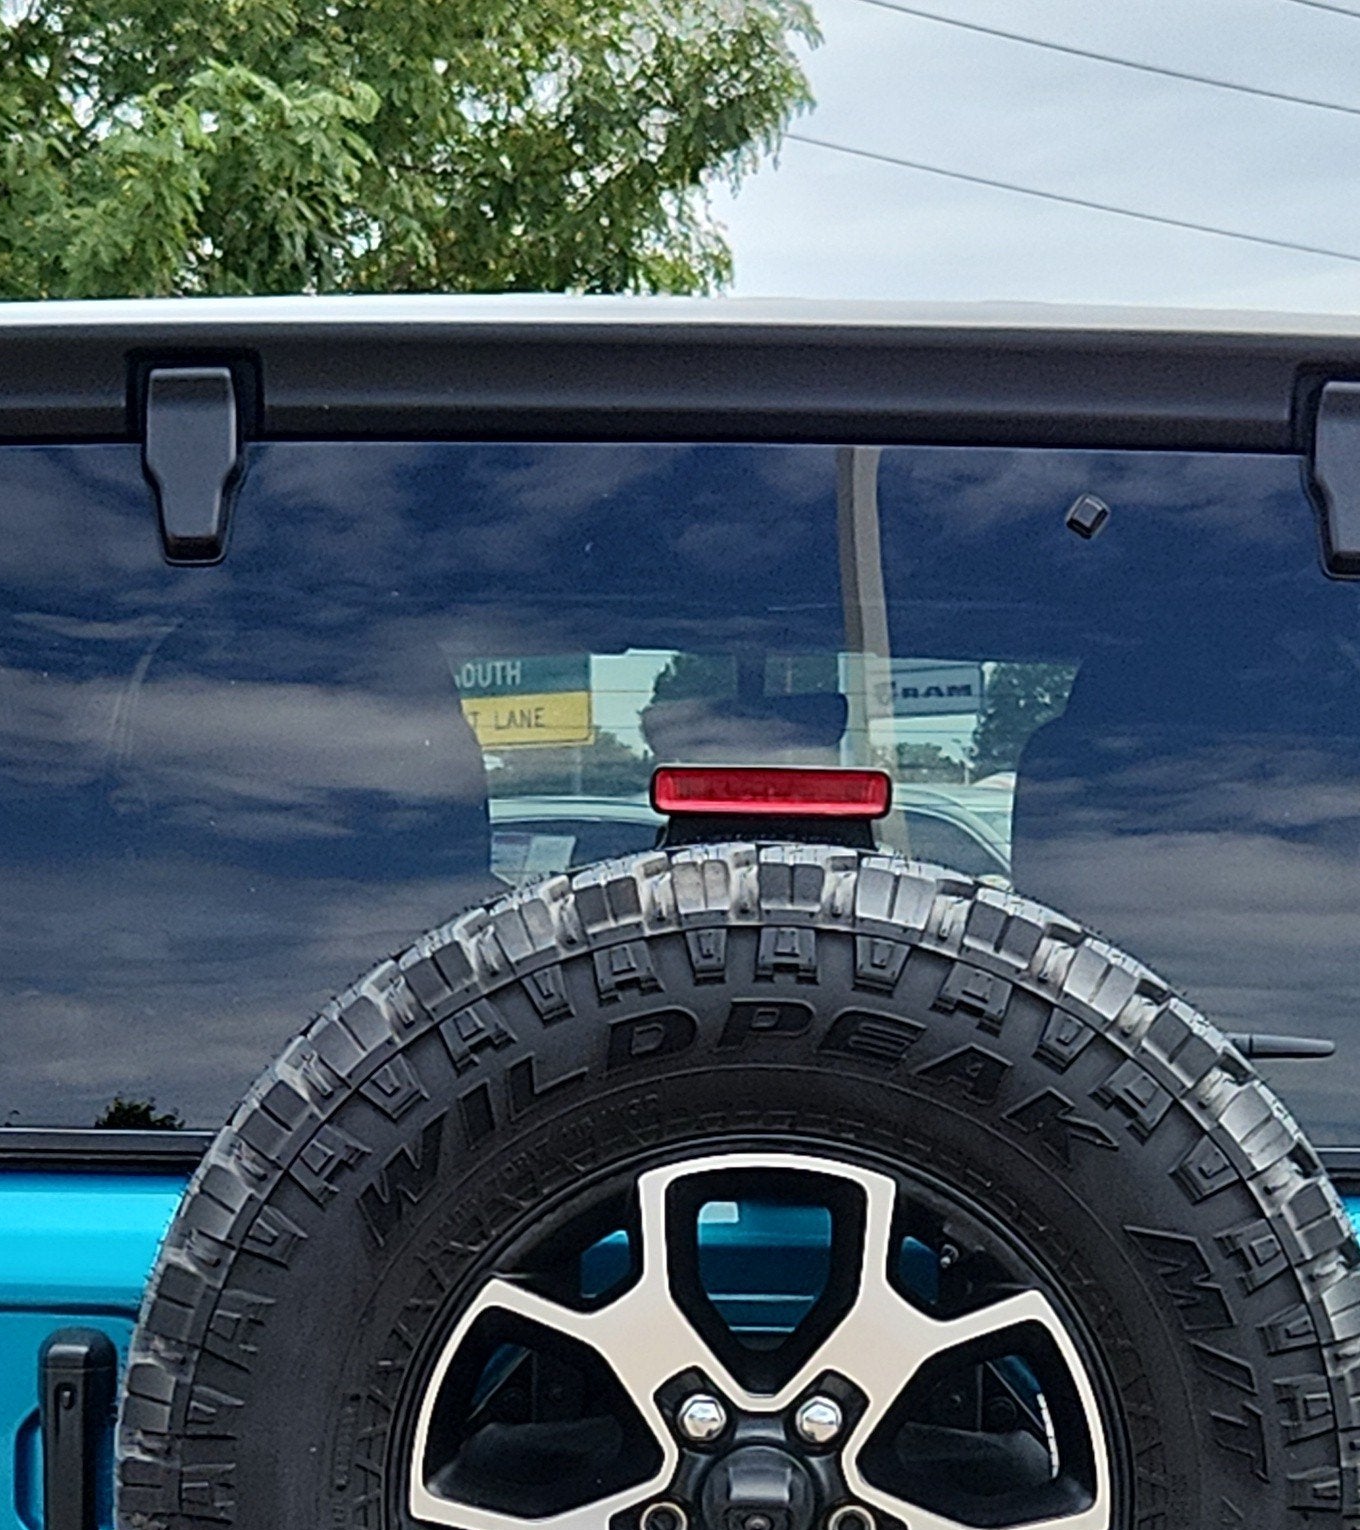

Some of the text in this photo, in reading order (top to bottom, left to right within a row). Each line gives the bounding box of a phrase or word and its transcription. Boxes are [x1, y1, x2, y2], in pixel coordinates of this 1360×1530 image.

[901, 684, 972, 699] RAM
[494, 707, 545, 731] LANE
[358, 996, 1121, 1248] WILDPEAK
